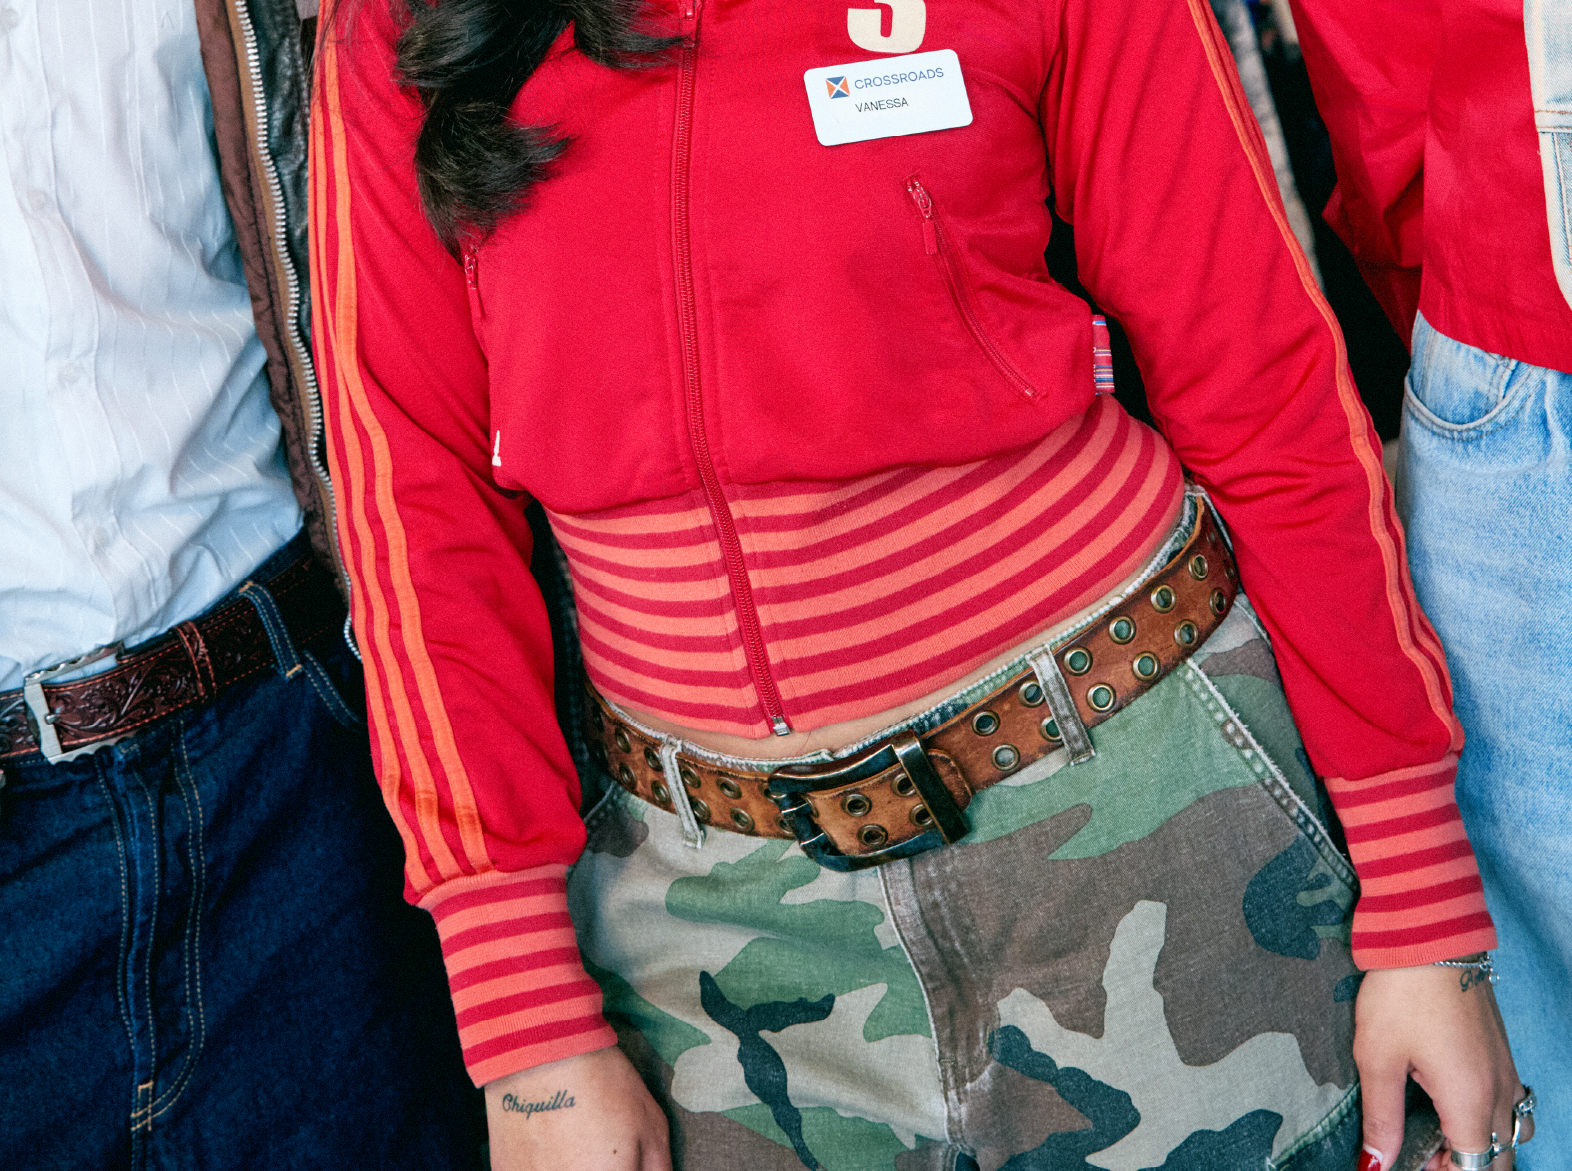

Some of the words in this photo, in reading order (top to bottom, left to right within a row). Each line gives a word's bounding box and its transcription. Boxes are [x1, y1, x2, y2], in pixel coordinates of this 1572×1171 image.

[854, 67, 945, 90] CROSSROADS
[855, 97, 910, 113] VANESSA
[502, 1089, 577, 1121] Chiquilla
